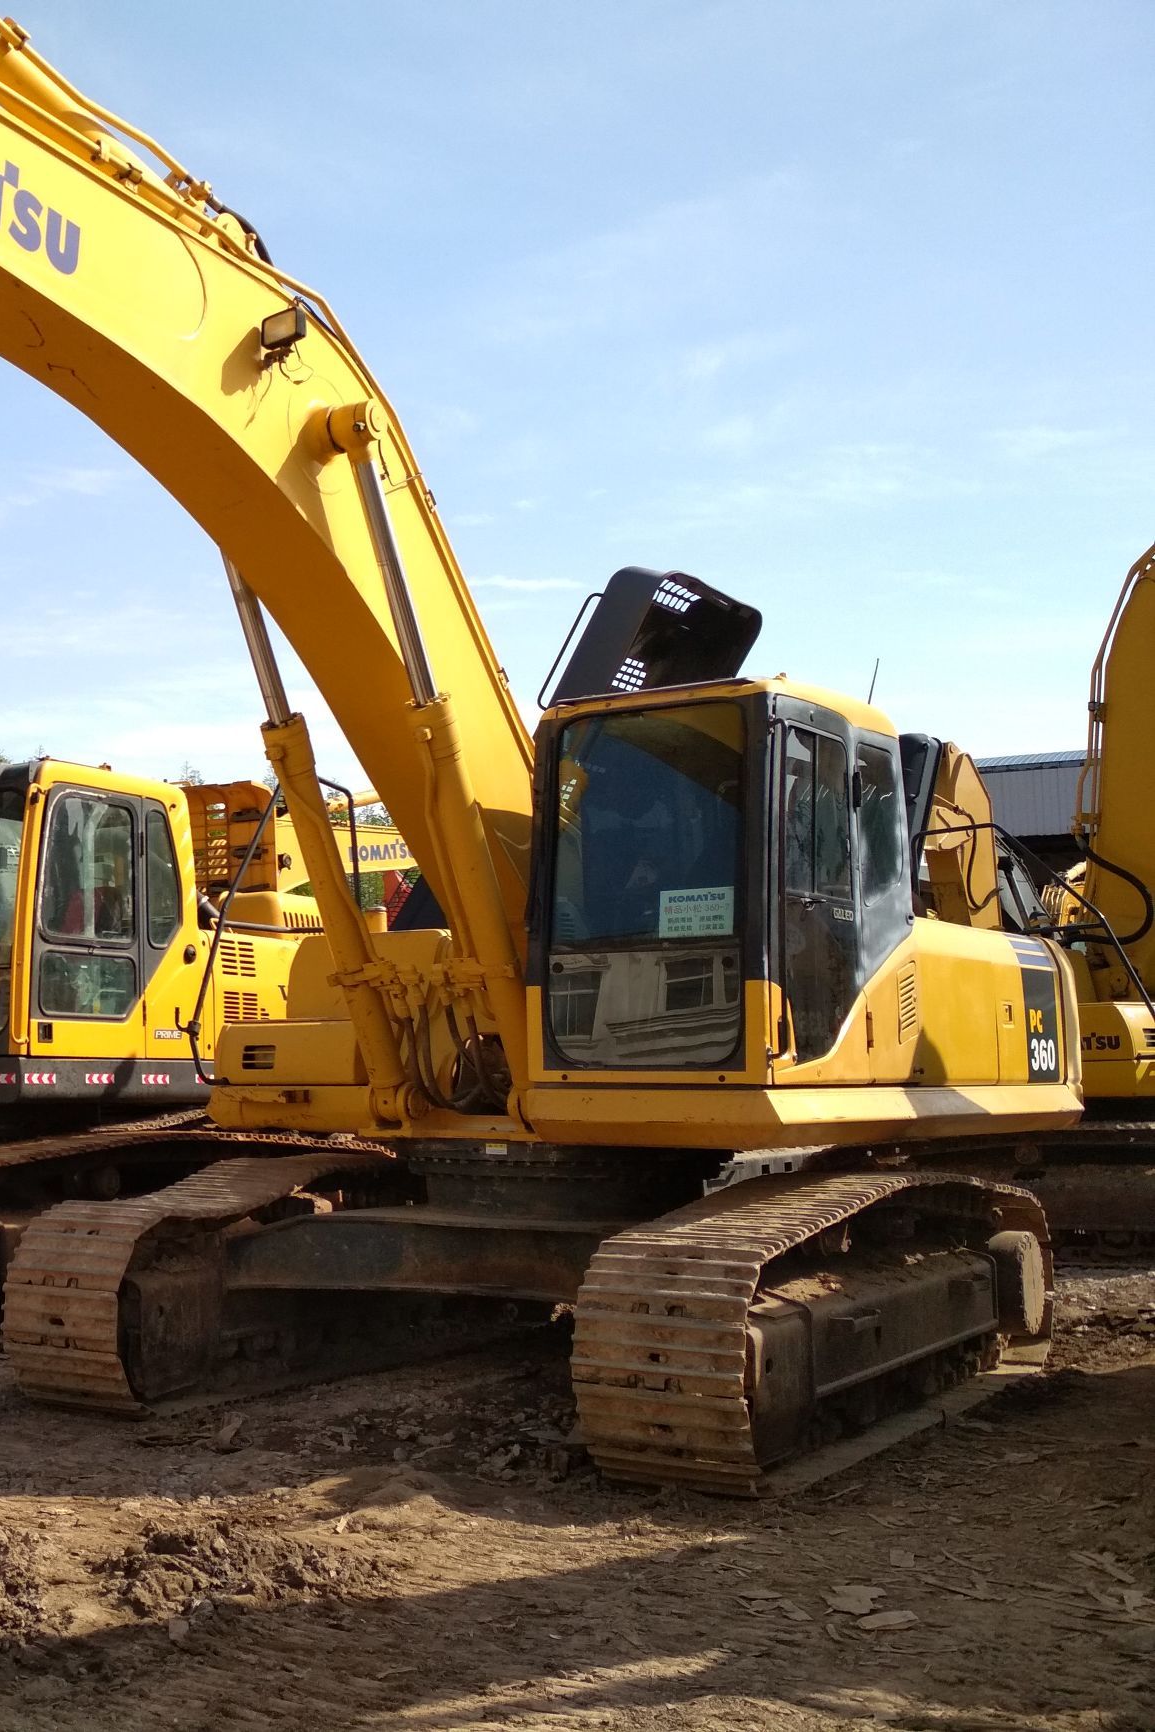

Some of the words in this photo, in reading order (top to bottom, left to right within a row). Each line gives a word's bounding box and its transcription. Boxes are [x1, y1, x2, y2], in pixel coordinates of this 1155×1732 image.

[668, 892, 726, 903] KOMATSU
[1029, 1008, 1044, 1034] PC
[155, 1030, 182, 1039] PRIME
[1030, 1038, 1056, 1071] 360
